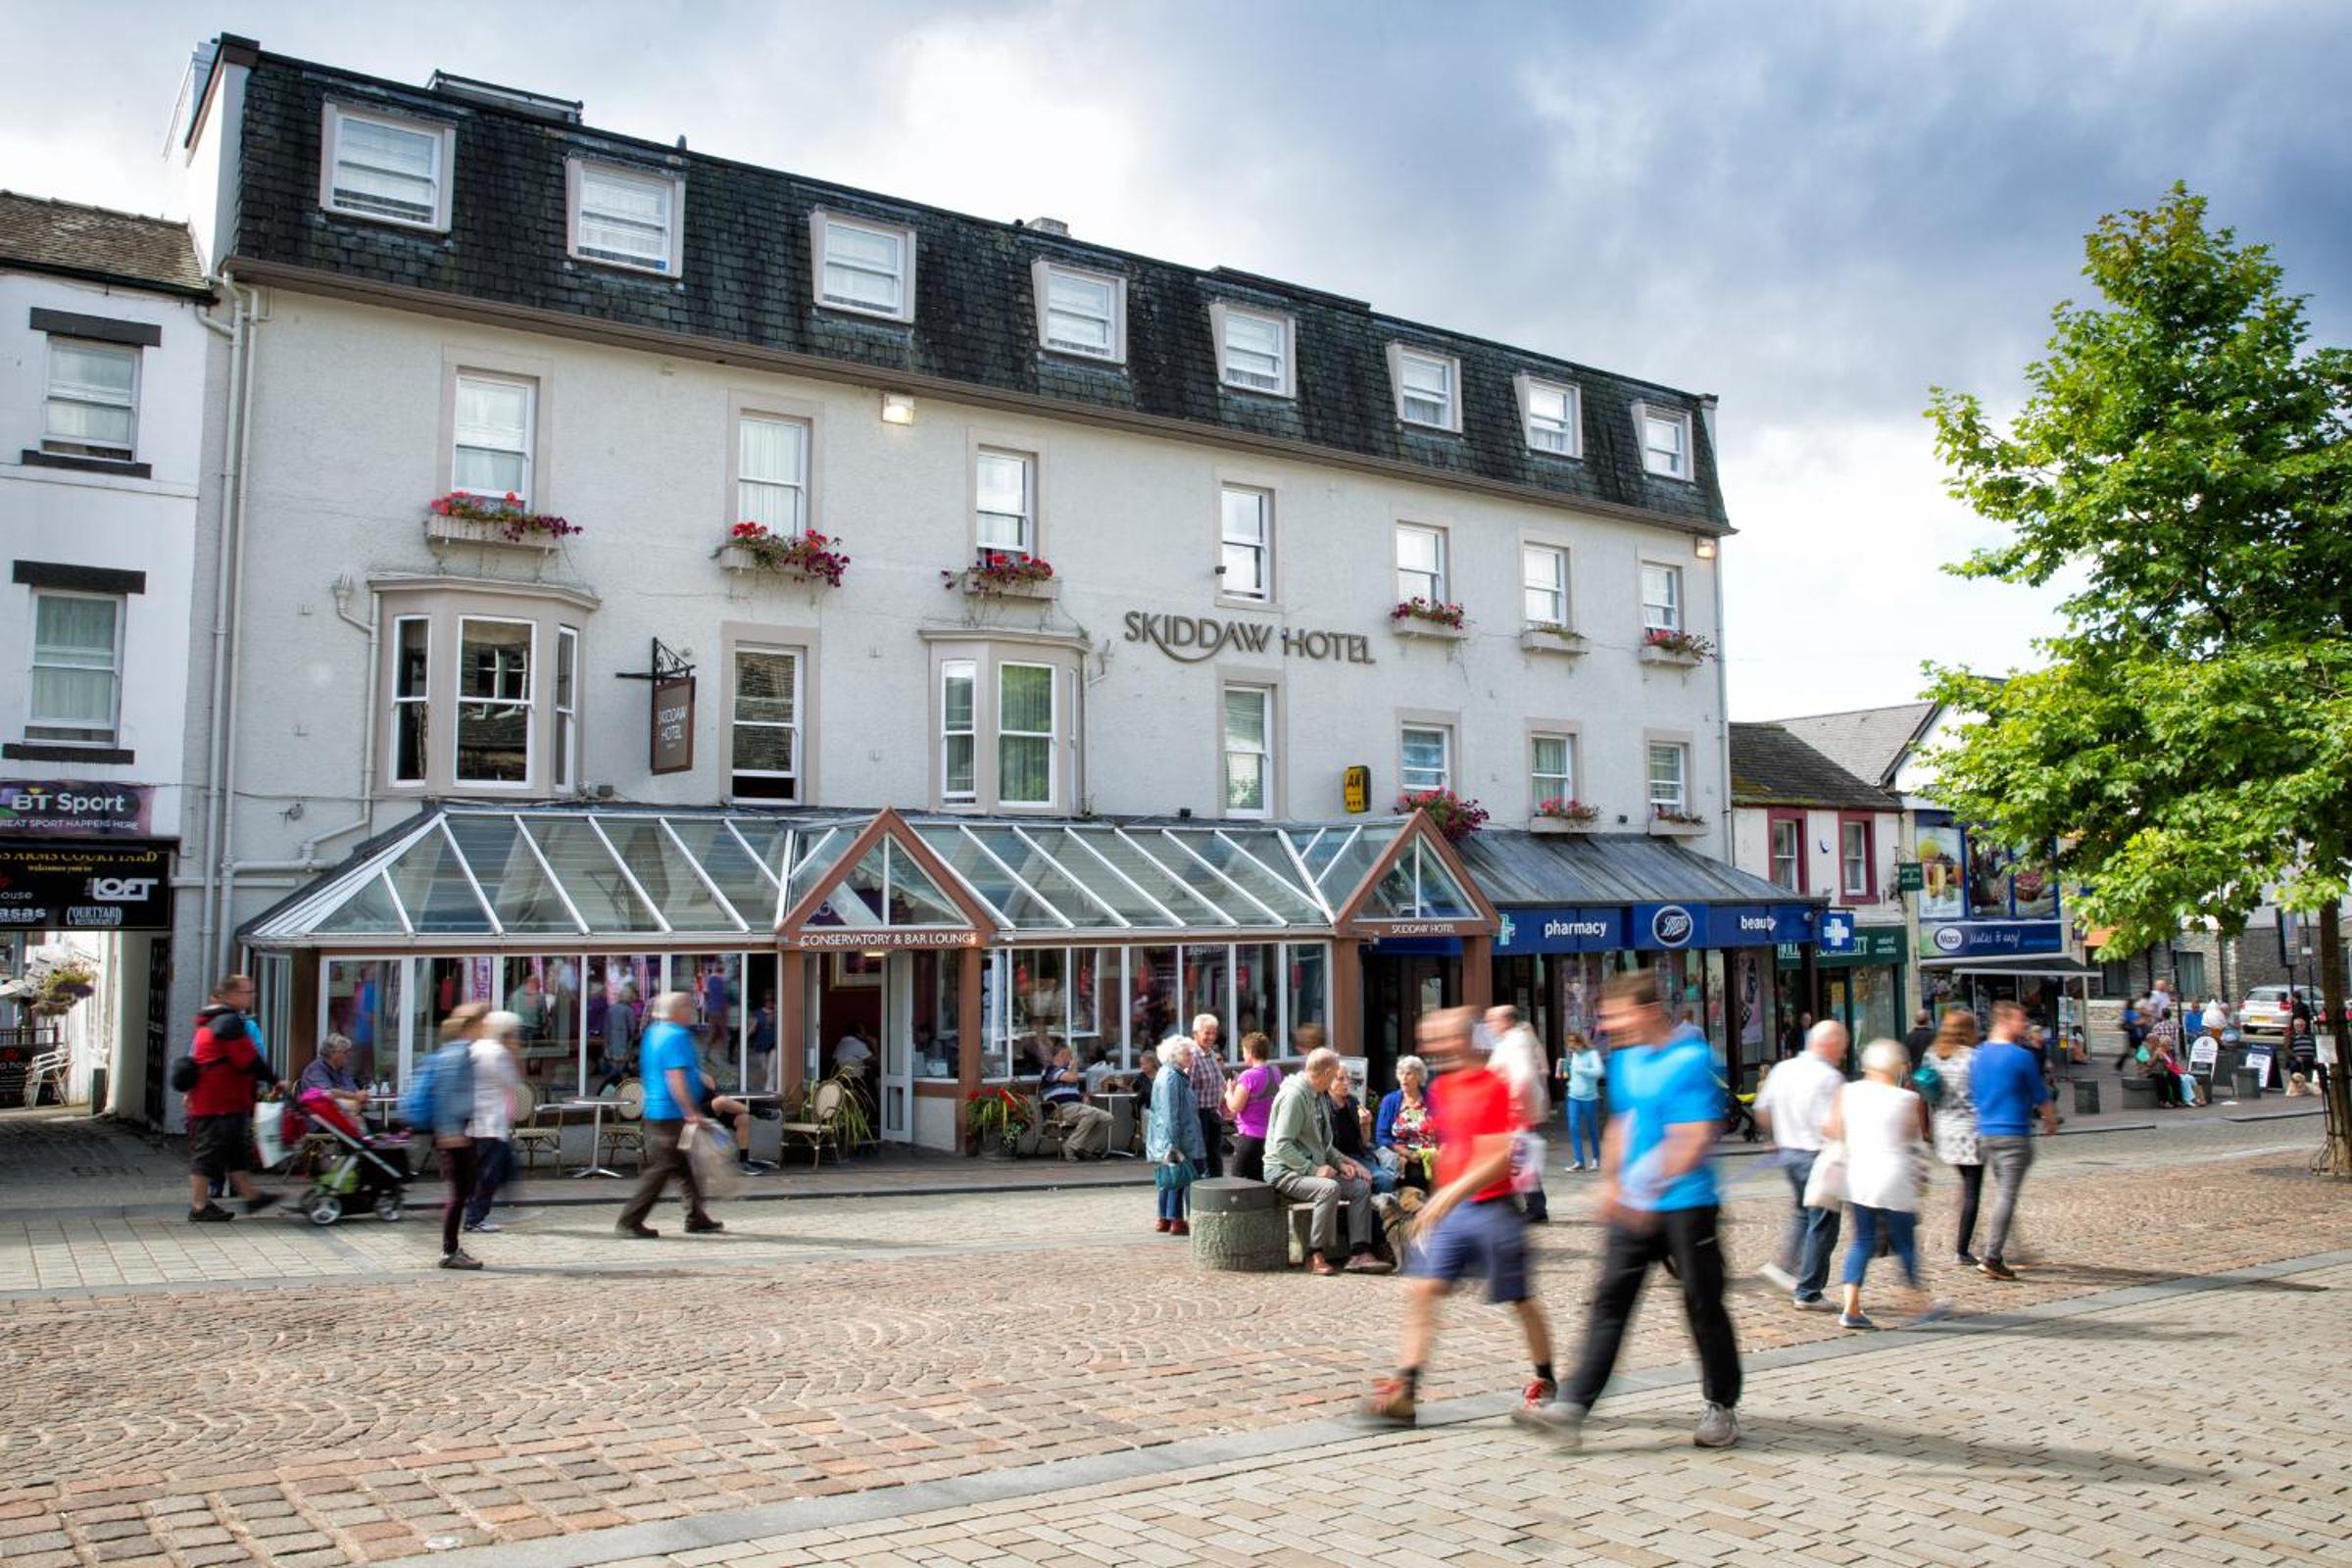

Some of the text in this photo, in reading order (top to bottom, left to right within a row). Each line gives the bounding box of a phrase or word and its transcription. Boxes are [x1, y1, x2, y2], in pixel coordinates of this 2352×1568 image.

[1124, 611, 1376, 665] SKIDDAW HOTEL
[12, 793, 125, 814] BT Sport
[29, 819, 63, 829] SPORT
[67, 819, 111, 829] HAPPENS
[113, 821, 139, 830] HERE
[93, 878, 159, 901] LOFT
[67, 906, 122, 925] COURTYARD
[1544, 918, 1607, 939] pharmacy
[801, 932, 976, 947] CONSERVATORY & BAR LOUNGE
